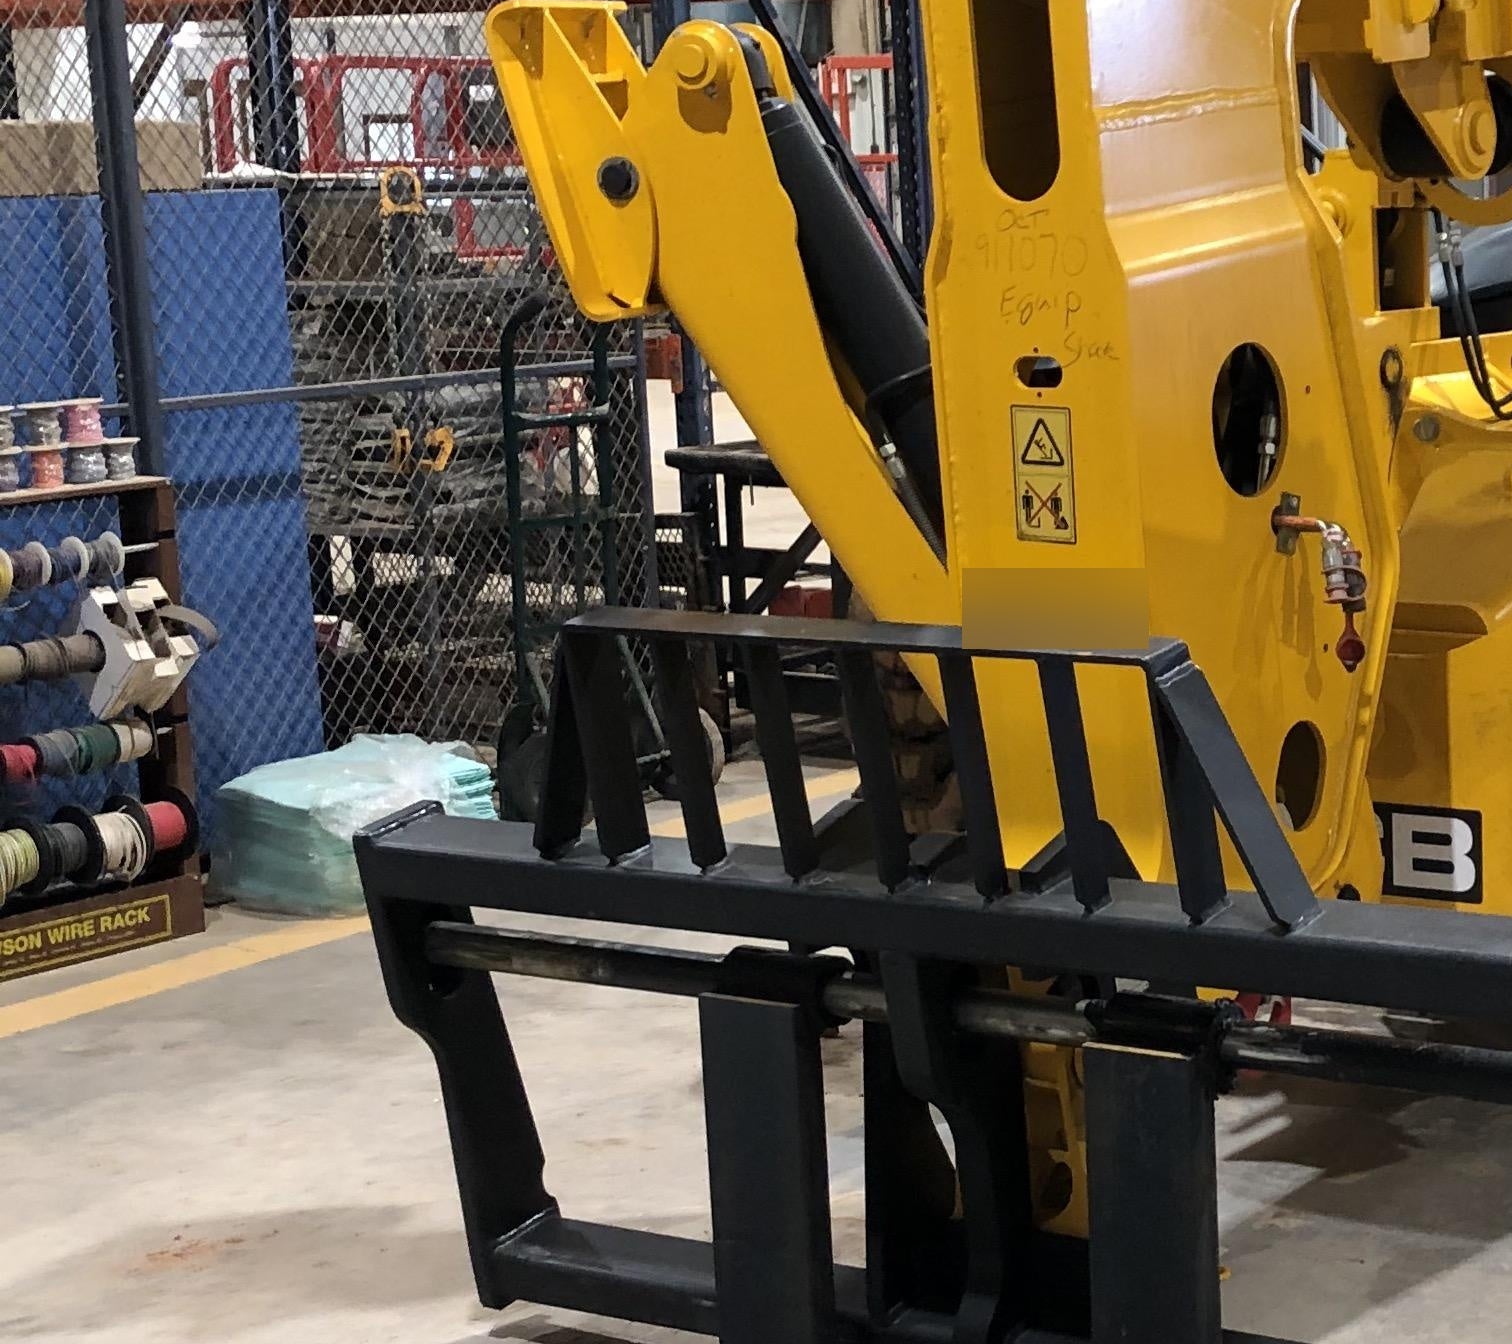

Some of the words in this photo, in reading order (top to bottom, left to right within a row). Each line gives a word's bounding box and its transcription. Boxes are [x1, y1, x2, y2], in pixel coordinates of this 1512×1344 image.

[0, 931, 42, 957] SON
[47, 918, 96, 945] WIRE
[100, 906, 151, 933] RACK
